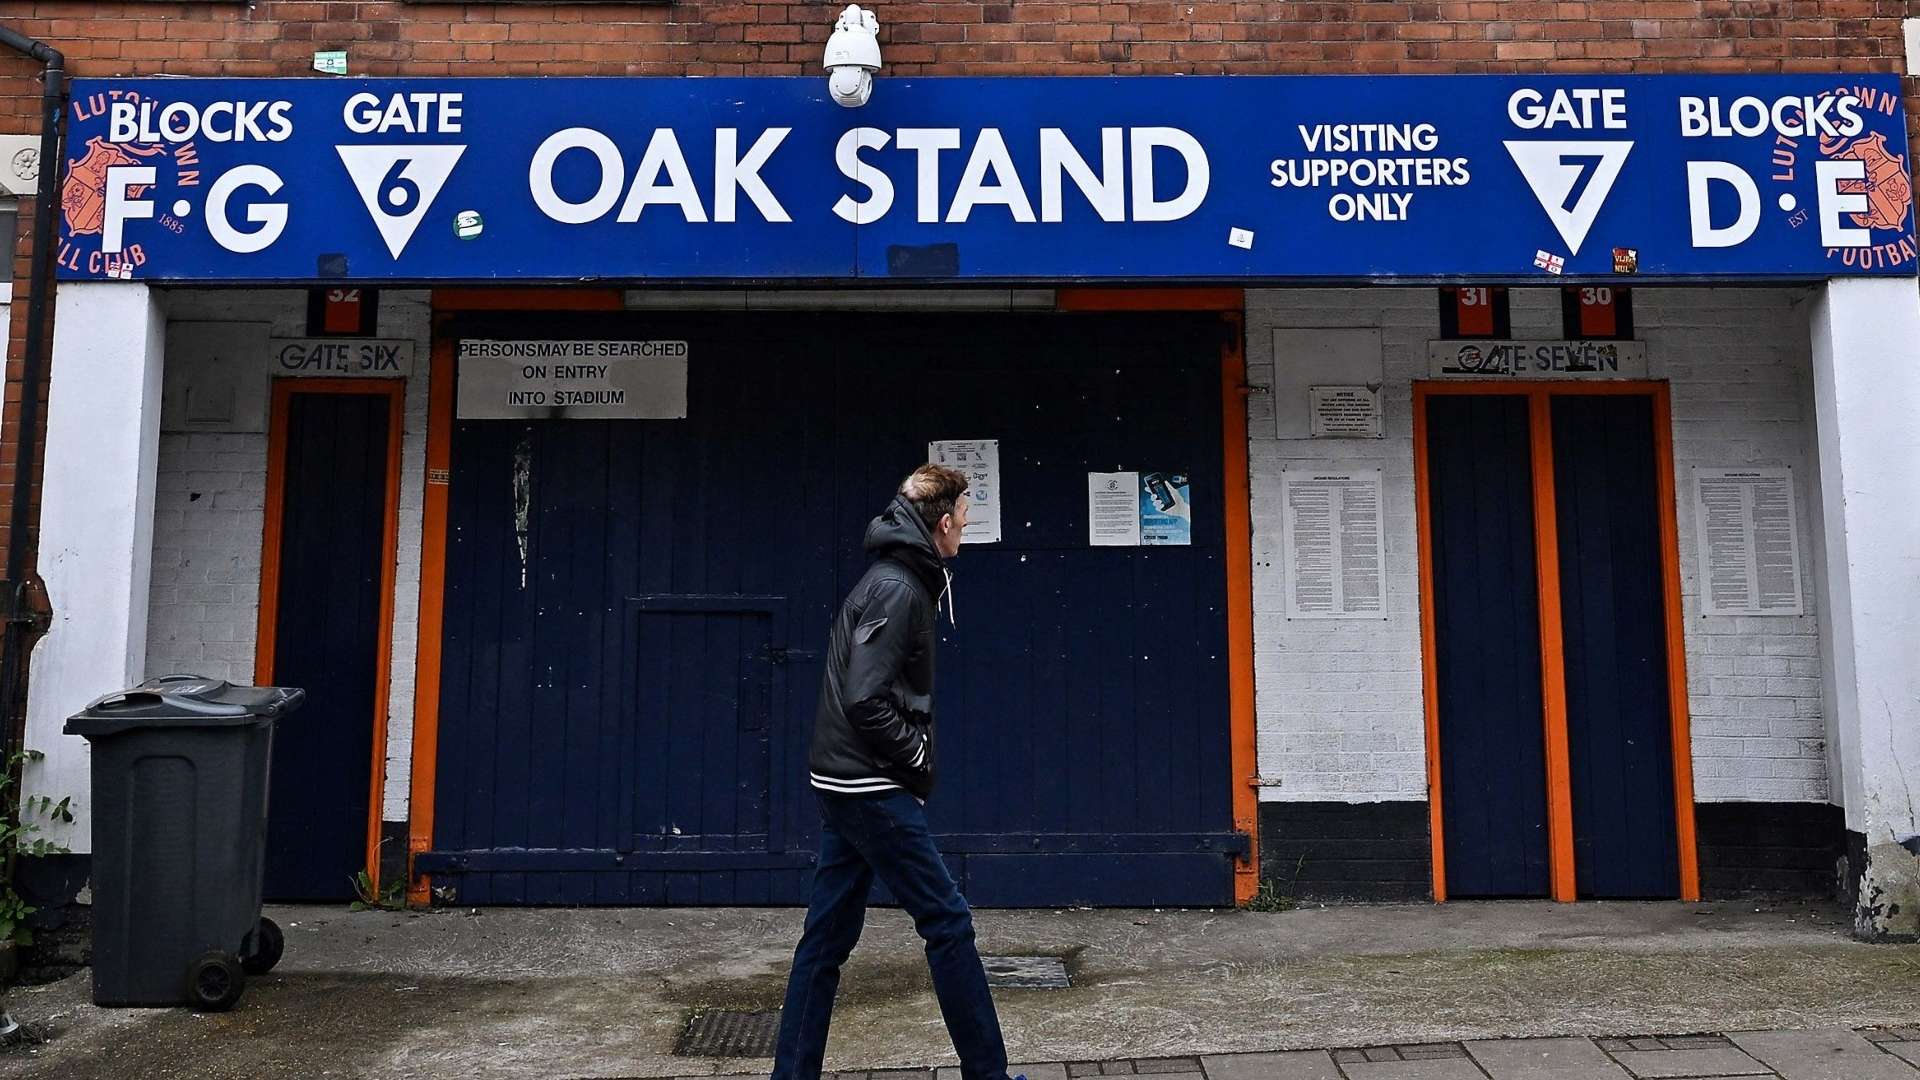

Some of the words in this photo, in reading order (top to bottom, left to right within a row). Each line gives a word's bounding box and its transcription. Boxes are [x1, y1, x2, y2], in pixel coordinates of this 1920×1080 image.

[73, 90, 158, 121] LUT
[344, 92, 462, 133] GATE
[1508, 88, 1627, 129] GATE
[1680, 96, 1864, 137] BLOCKS
[110, 100, 292, 142] BLOCKS
[1299, 123, 1438, 152] VISITING
[529, 127, 792, 224] OAK
[831, 126, 1209, 224] STAND
[1270, 157, 1470, 187] SUPPORTERS
[1559, 154, 1604, 213] 7
[377, 159, 420, 216] 6
[1328, 192, 1413, 221] ONLY
[1788, 208, 1809, 229] EST
[159, 213, 184, 234] 1885
[56, 236, 80, 271] LL
[1461, 287, 1487, 305] 31
[1582, 287, 1611, 305] 30
[280, 344, 349, 371] GATE
[360, 345, 400, 371] SIX
[573, 343, 594, 357] BE
[598, 343, 686, 357] SEARCHED
[1458, 345, 1526, 372] GATE
[1536, 345, 1618, 372] SEVEN
[522, 365, 546, 379] ON
[555, 365, 608, 379] ENTRY
[508, 391, 546, 405] INTO
[554, 390, 625, 404] STADIUM
